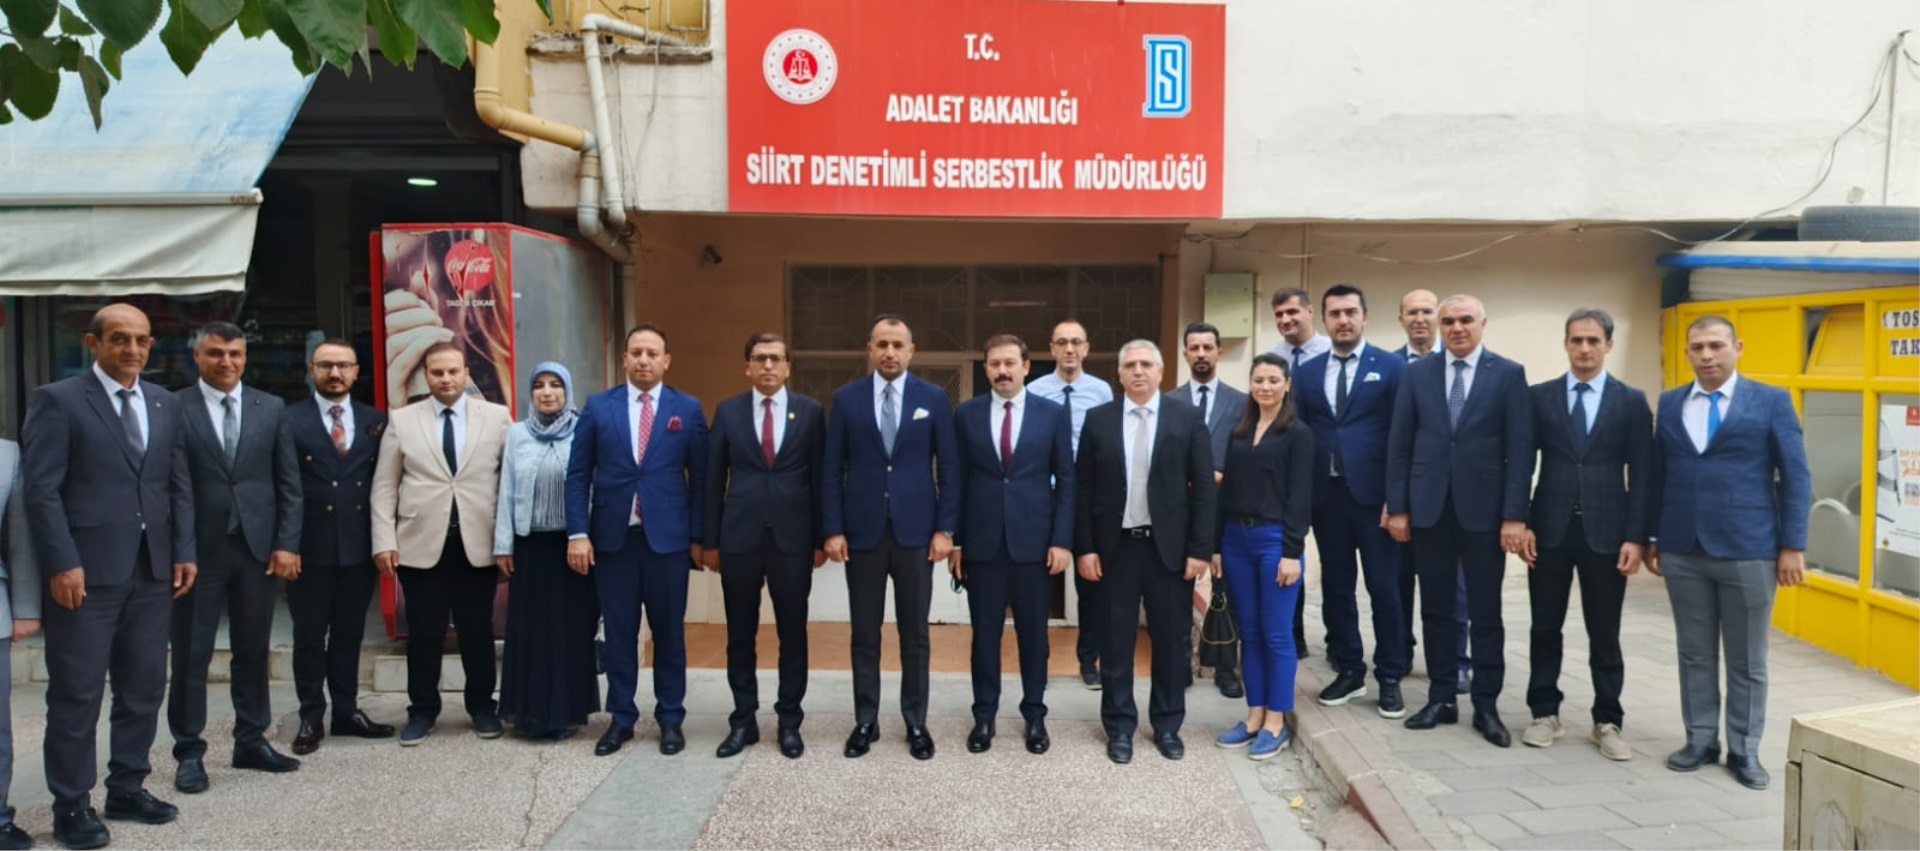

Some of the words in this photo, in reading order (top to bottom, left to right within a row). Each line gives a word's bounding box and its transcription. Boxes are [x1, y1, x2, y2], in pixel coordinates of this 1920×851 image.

[964, 33, 1000, 61] T.C.
[886, 93, 965, 123] ADALET
[969, 89, 1079, 125] BAKANLIĞI
[747, 146, 805, 185] SİİRT
[811, 149, 927, 187] DENETİMLİ
[933, 152, 1064, 189] SERBESTLİK
[1075, 153, 1207, 190] MÜDÜRLÜĞÜ
[447, 257, 492, 273] CocCola
